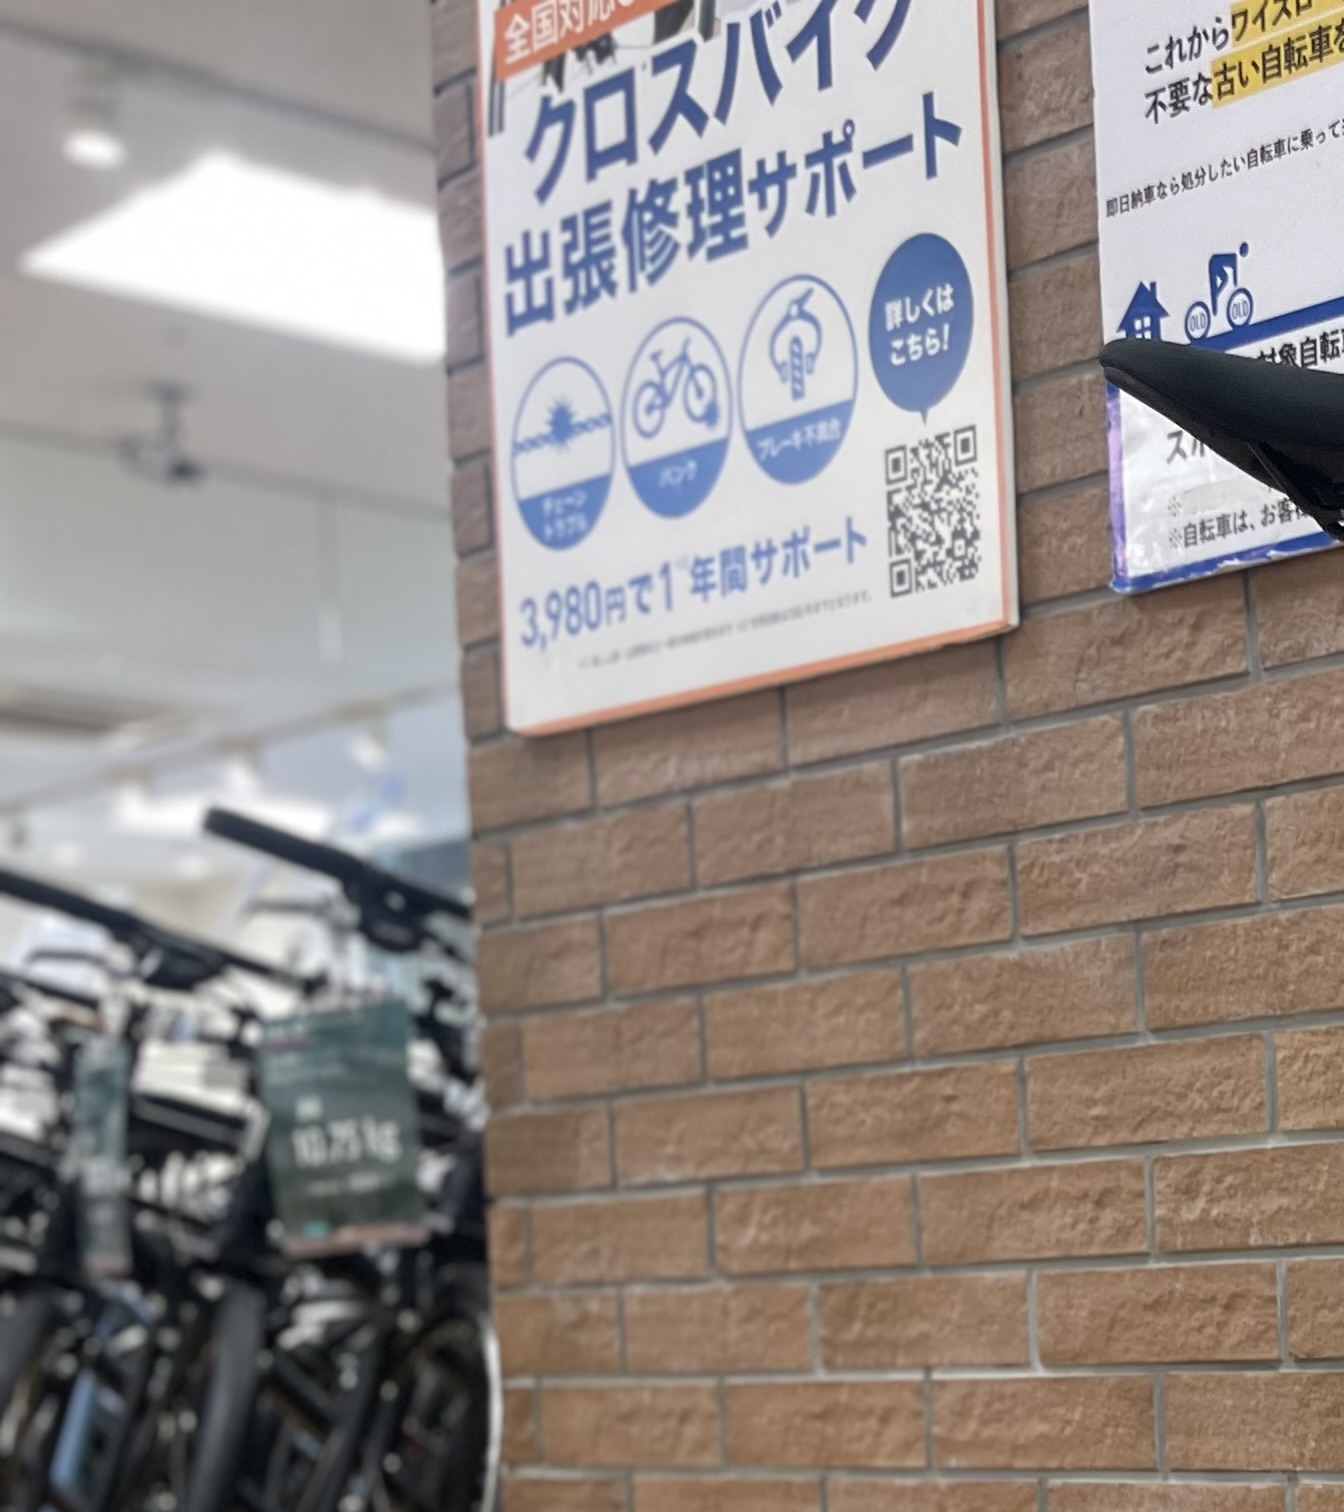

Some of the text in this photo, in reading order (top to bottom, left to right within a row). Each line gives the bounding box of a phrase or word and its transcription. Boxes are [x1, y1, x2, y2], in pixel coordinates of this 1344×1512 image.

[504, 0, 635, 64] 全国対応
[525, 0, 912, 205] クロスバイク
[504, 90, 963, 338] 出張修理サポート
[884, 282, 955, 332] 詳しくは
[1190, 298, 1250, 332] OLD OLD
